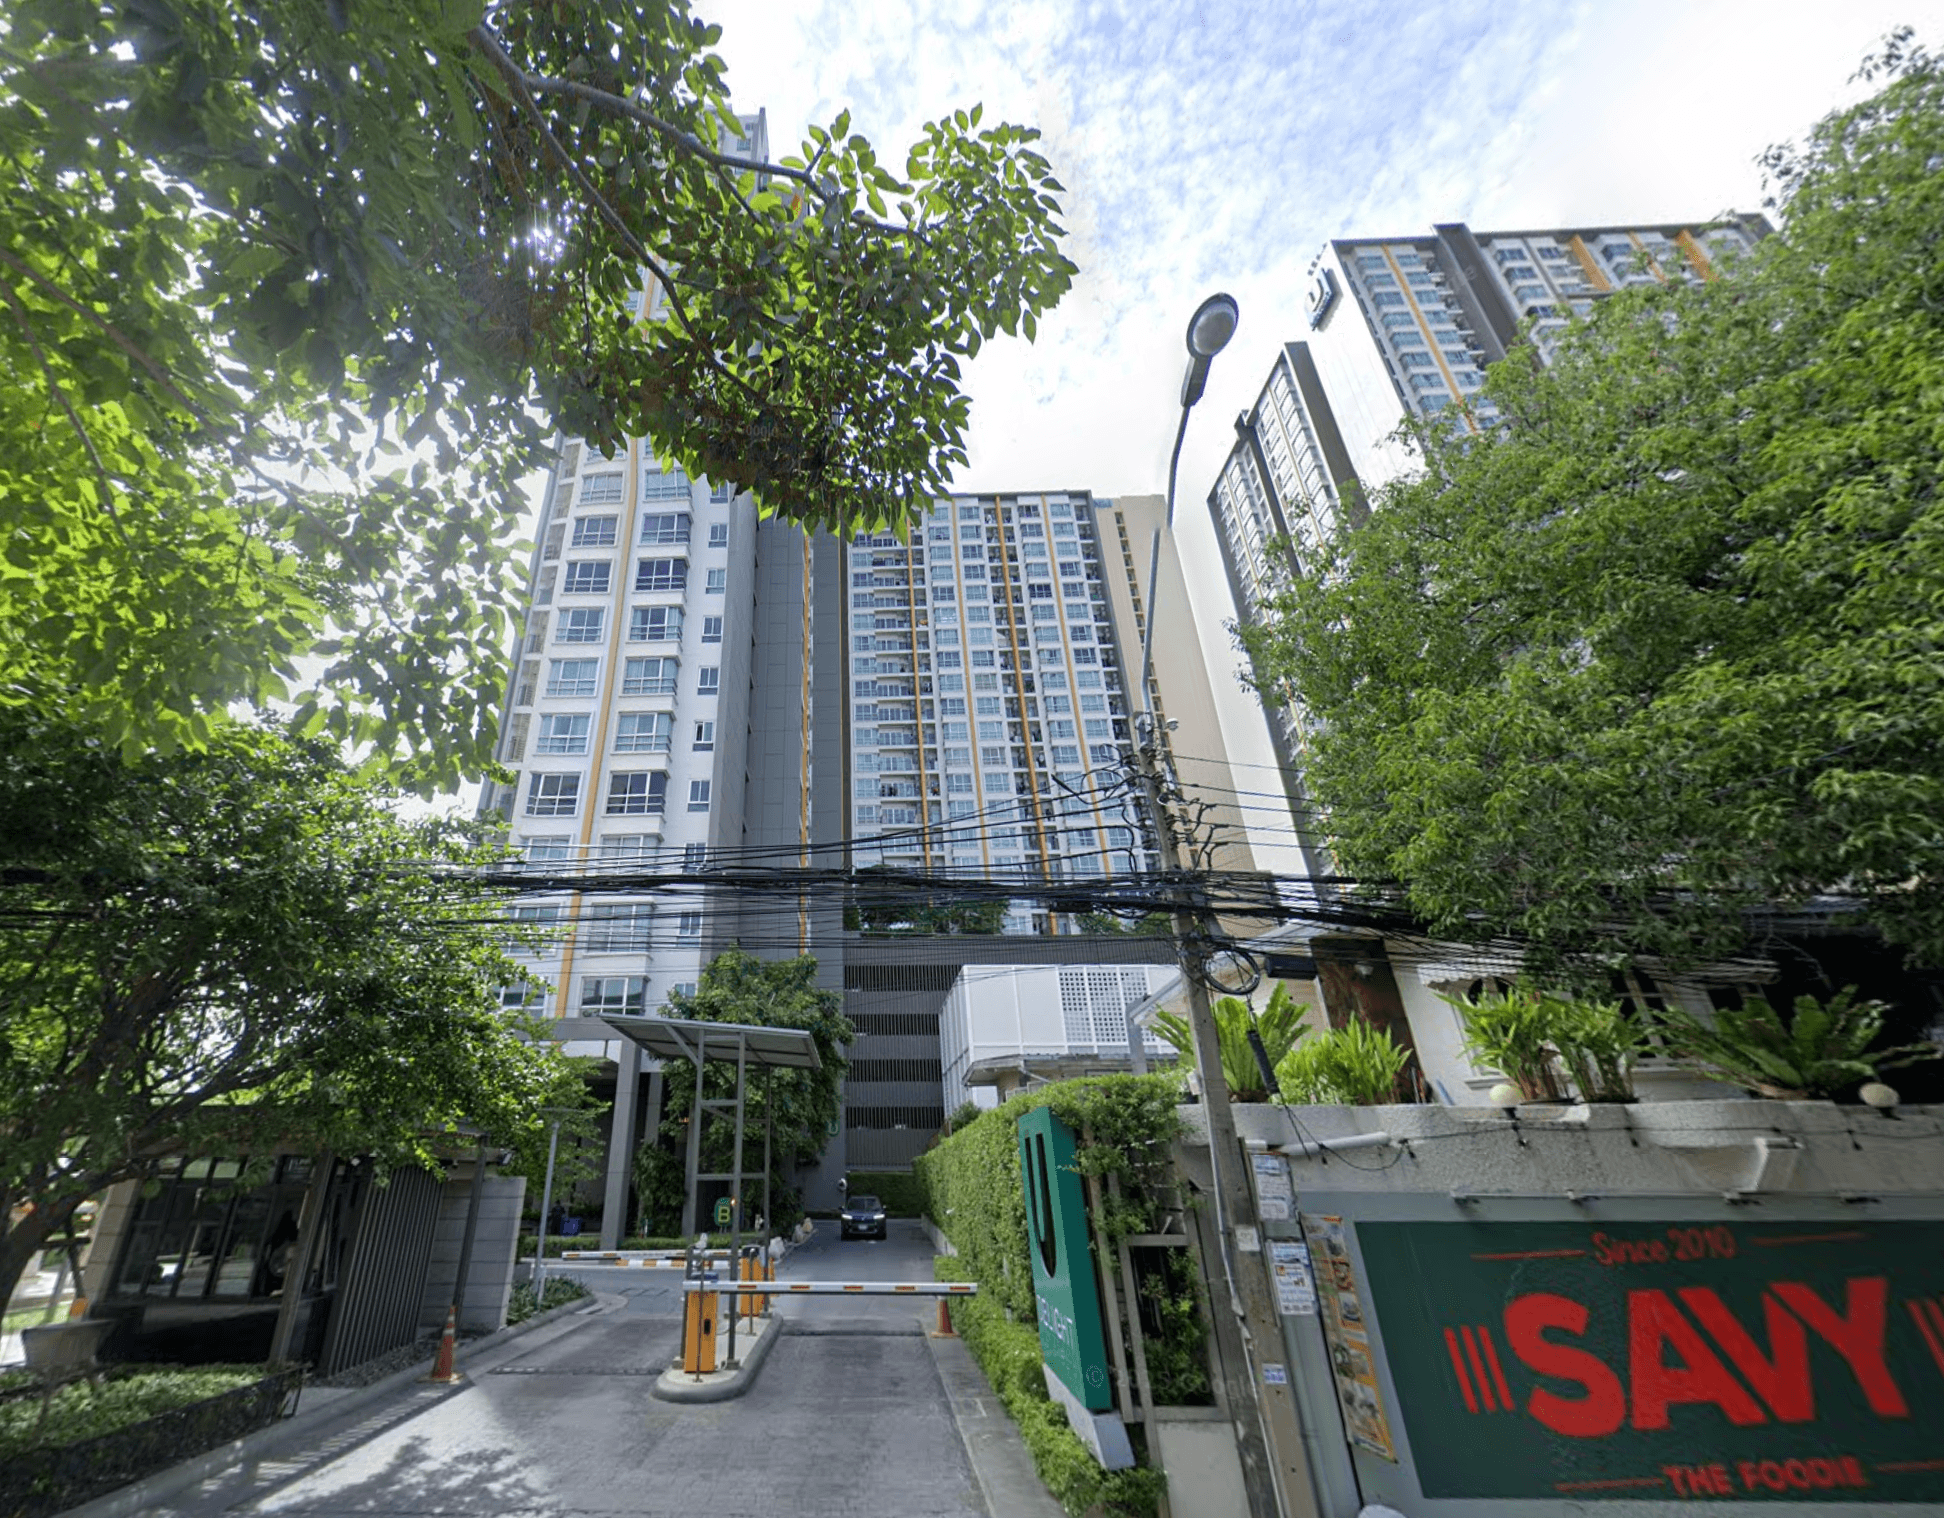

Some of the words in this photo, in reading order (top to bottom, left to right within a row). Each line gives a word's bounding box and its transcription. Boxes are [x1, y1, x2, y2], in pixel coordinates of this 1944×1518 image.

[717, 1206, 731, 1223] B
[1592, 1232, 1666, 1265] Since
[1667, 1226, 1735, 1261] 2010
[1504, 1277, 1909, 1438] SAVY
[1662, 1464, 1734, 1497] THE
